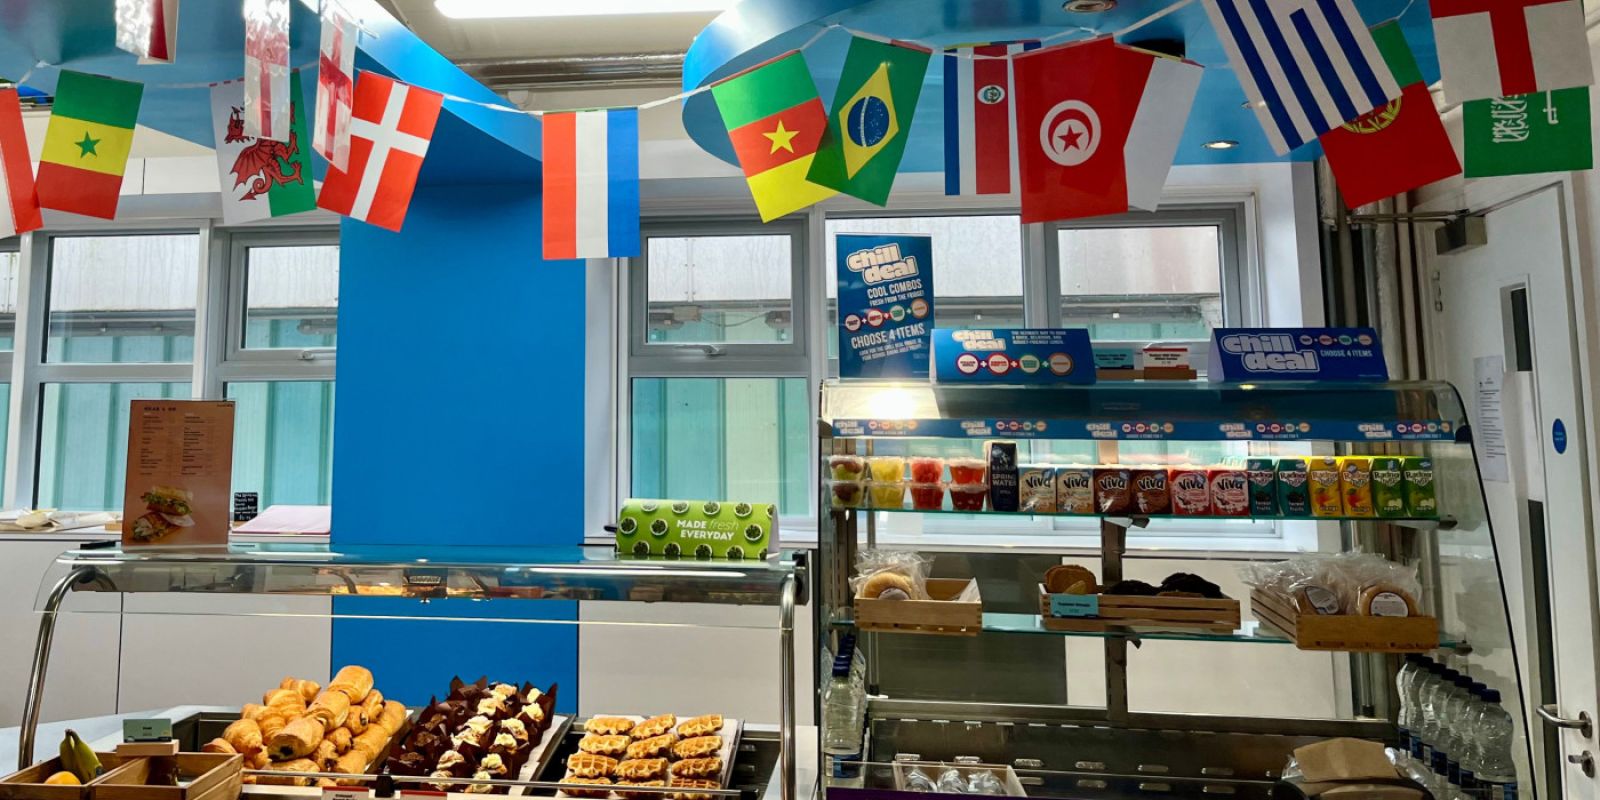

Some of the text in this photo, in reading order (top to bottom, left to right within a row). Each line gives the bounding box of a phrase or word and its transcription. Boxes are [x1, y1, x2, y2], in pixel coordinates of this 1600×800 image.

[847, 244, 900, 272] chill
[863, 257, 917, 284] deal
[867, 278, 922, 299] COOL COMBOS
[851, 330, 888, 349] CHOOSE
[888, 329, 896, 341] 4
[896, 322, 925, 340] ITEMS
[952, 330, 994, 342] chill
[962, 338, 1006, 351] deal
[1222, 334, 1296, 353] chill
[1244, 350, 1319, 371] deal
[1320, 349, 1373, 357] CHOOSE 4 ITEMS
[676, 519, 740, 530] MADE fresh
[680, 530, 735, 541] EVERYDAY
